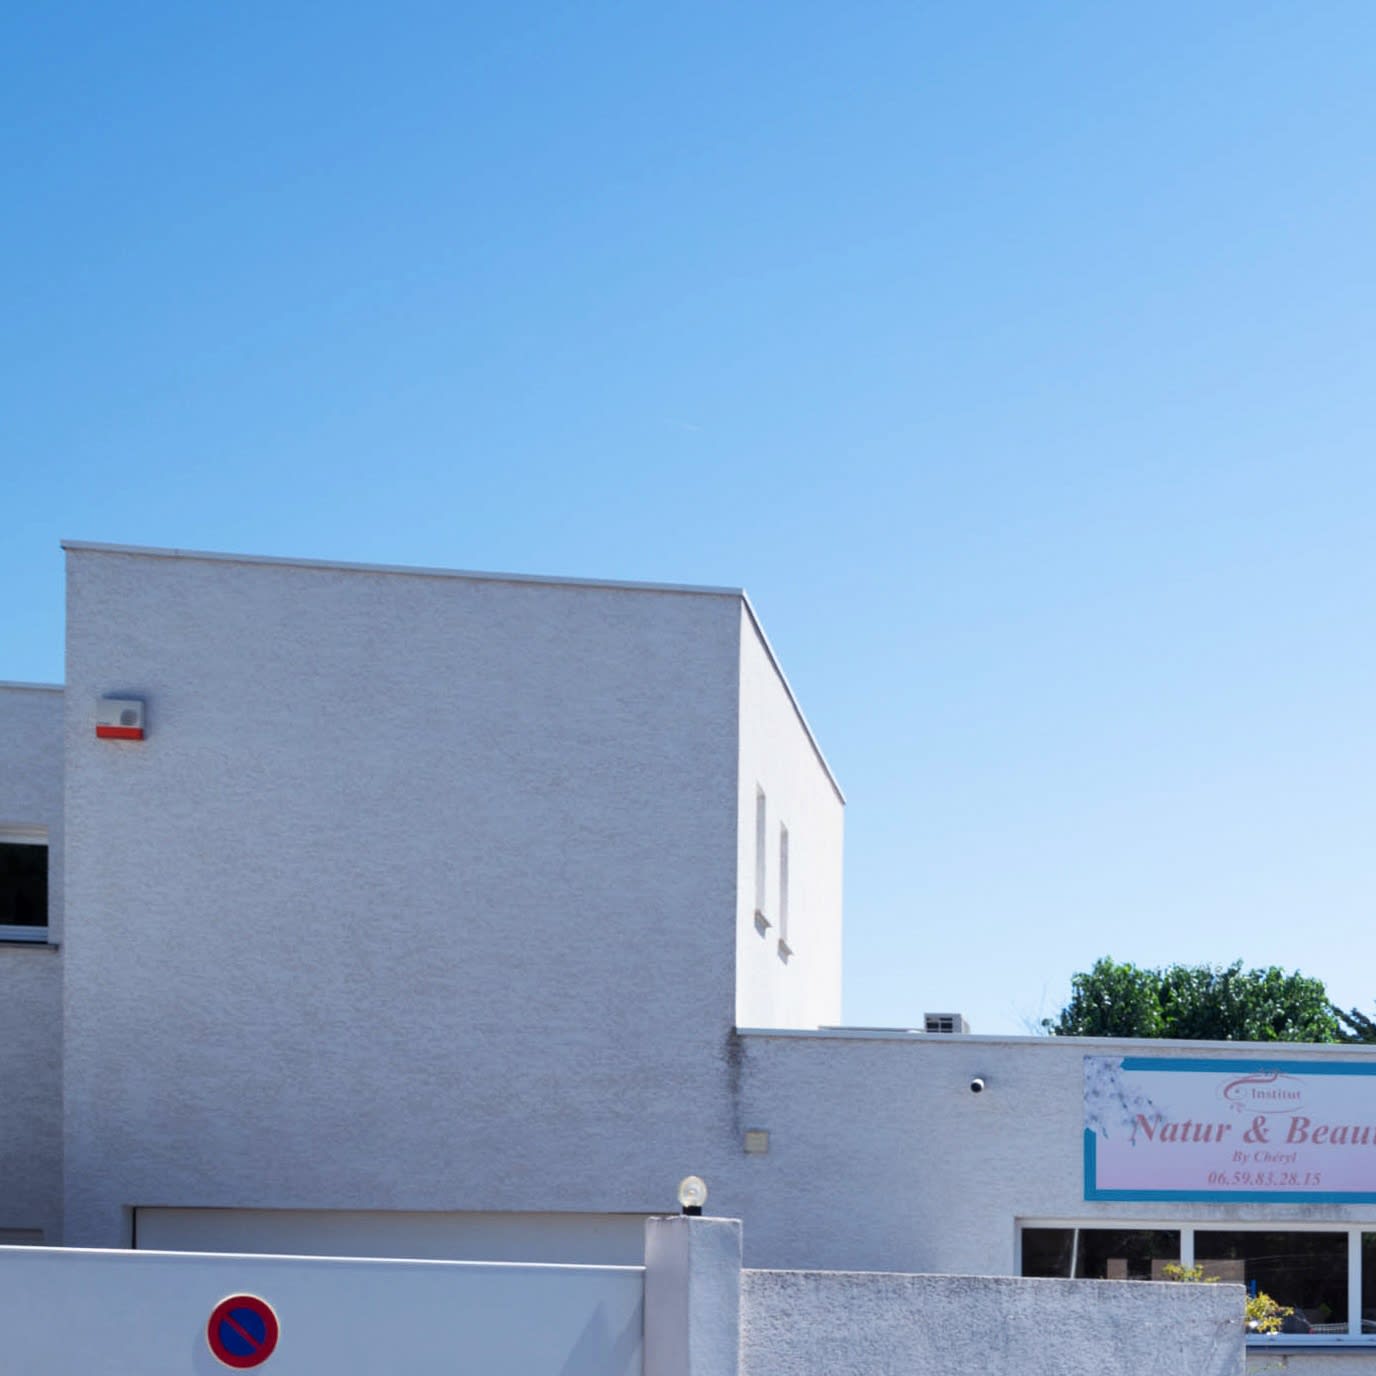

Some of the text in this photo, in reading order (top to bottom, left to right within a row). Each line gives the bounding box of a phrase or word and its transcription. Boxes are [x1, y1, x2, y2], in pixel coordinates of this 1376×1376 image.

[1250, 1086, 1302, 1100] Institut
[1130, 1113, 1232, 1144] Natur
[1242, 1114, 1270, 1145] &
[1231, 1149, 1249, 1166] By
